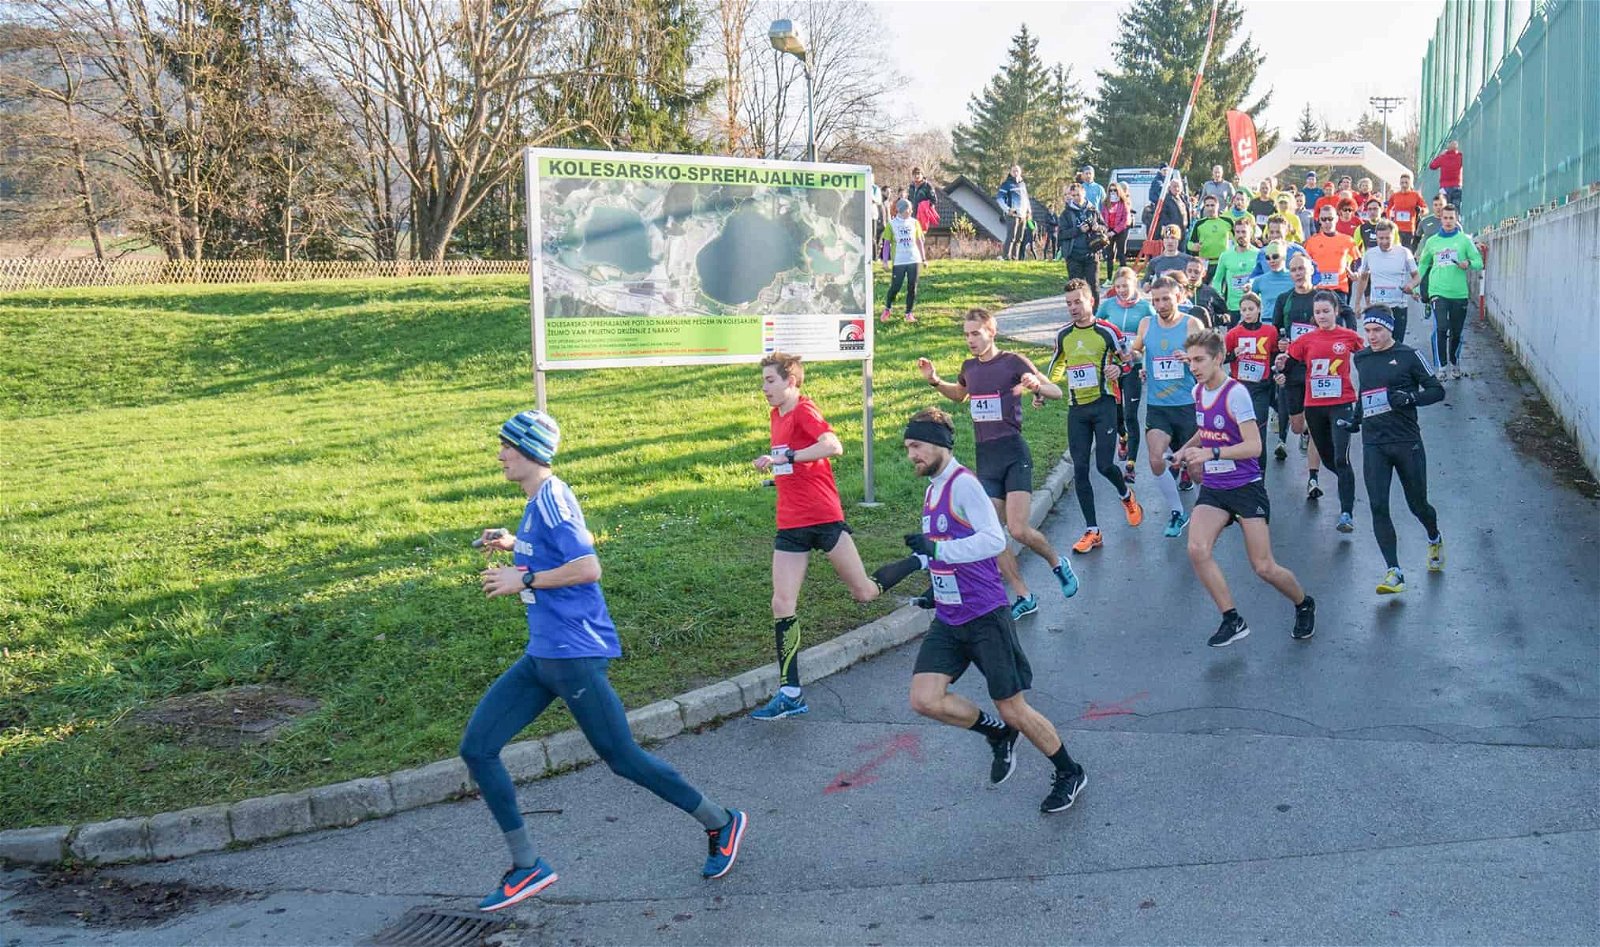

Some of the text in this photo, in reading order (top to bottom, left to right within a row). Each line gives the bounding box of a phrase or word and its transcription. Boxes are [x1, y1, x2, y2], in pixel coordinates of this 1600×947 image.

[548, 160, 858, 188] KOLESARSKO-SPREHAJALNE POTI
[1159, 360, 1172, 369] 17
[1244, 363, 1256, 372] 56
[1072, 369, 1085, 379] 30
[1318, 379, 1331, 388] 55
[976, 400, 988, 409] 41
[1367, 395, 1373, 405] 7
